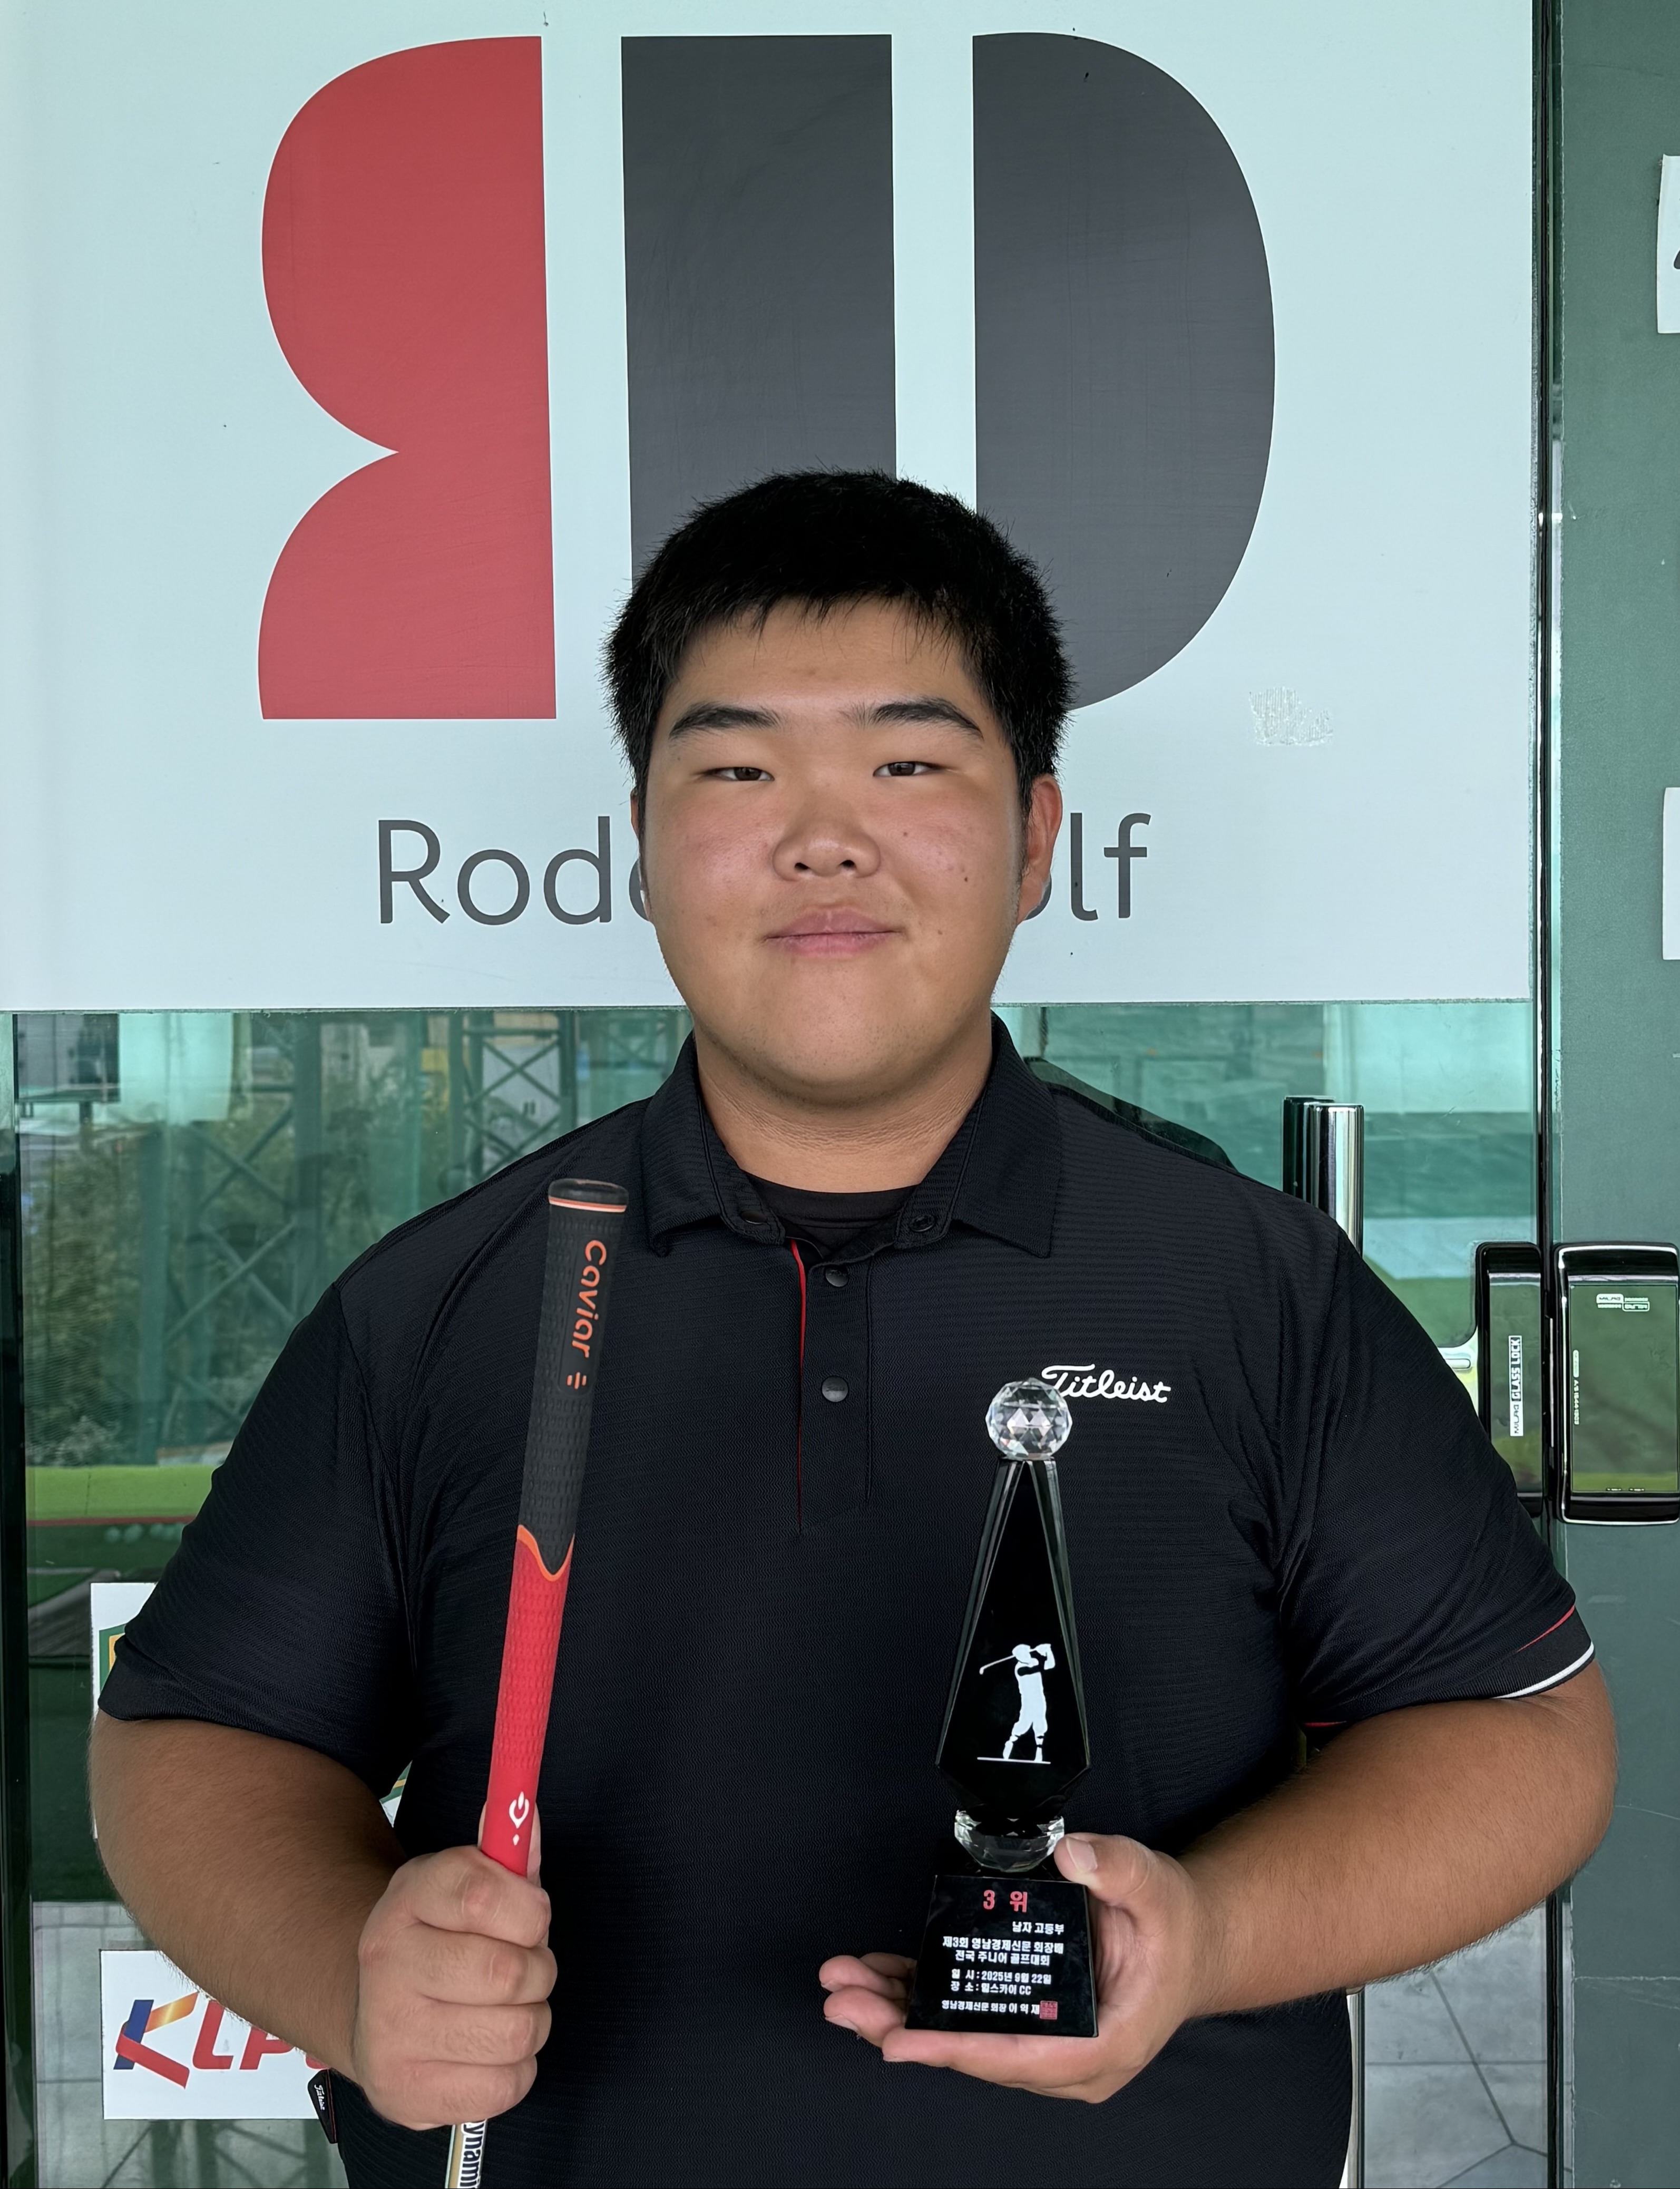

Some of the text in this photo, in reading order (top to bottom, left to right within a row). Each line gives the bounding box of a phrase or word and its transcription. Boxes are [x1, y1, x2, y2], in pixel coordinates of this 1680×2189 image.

[1024, 812, 1151, 921] lf
[572, 1240, 607, 1358] Caviar
[1511, 1339, 1520, 1365] LOCK
[1041, 1363, 1171, 1403] Titleist
[1511, 1367, 1521, 1400] GLASS
[983, 1890, 1028, 1913] 3 위
[1012, 1921, 1064, 1935] 남자 고등부
[942, 1936, 969, 1949] 제3회
[972, 1938, 1031, 1952] 영남경제신문
[955, 1950, 1050, 1966] 전국 주니어 골프대회
[981, 1971, 1013, 1982] 2025년
[1014, 1972, 1029, 1983] 9월
[1031, 1973, 1052, 1985] 22일
[941, 2000, 989, 2011] 영남경제신문
[990, 2002, 1007, 2013] 회장
[113, 1991, 332, 2089] KLP
